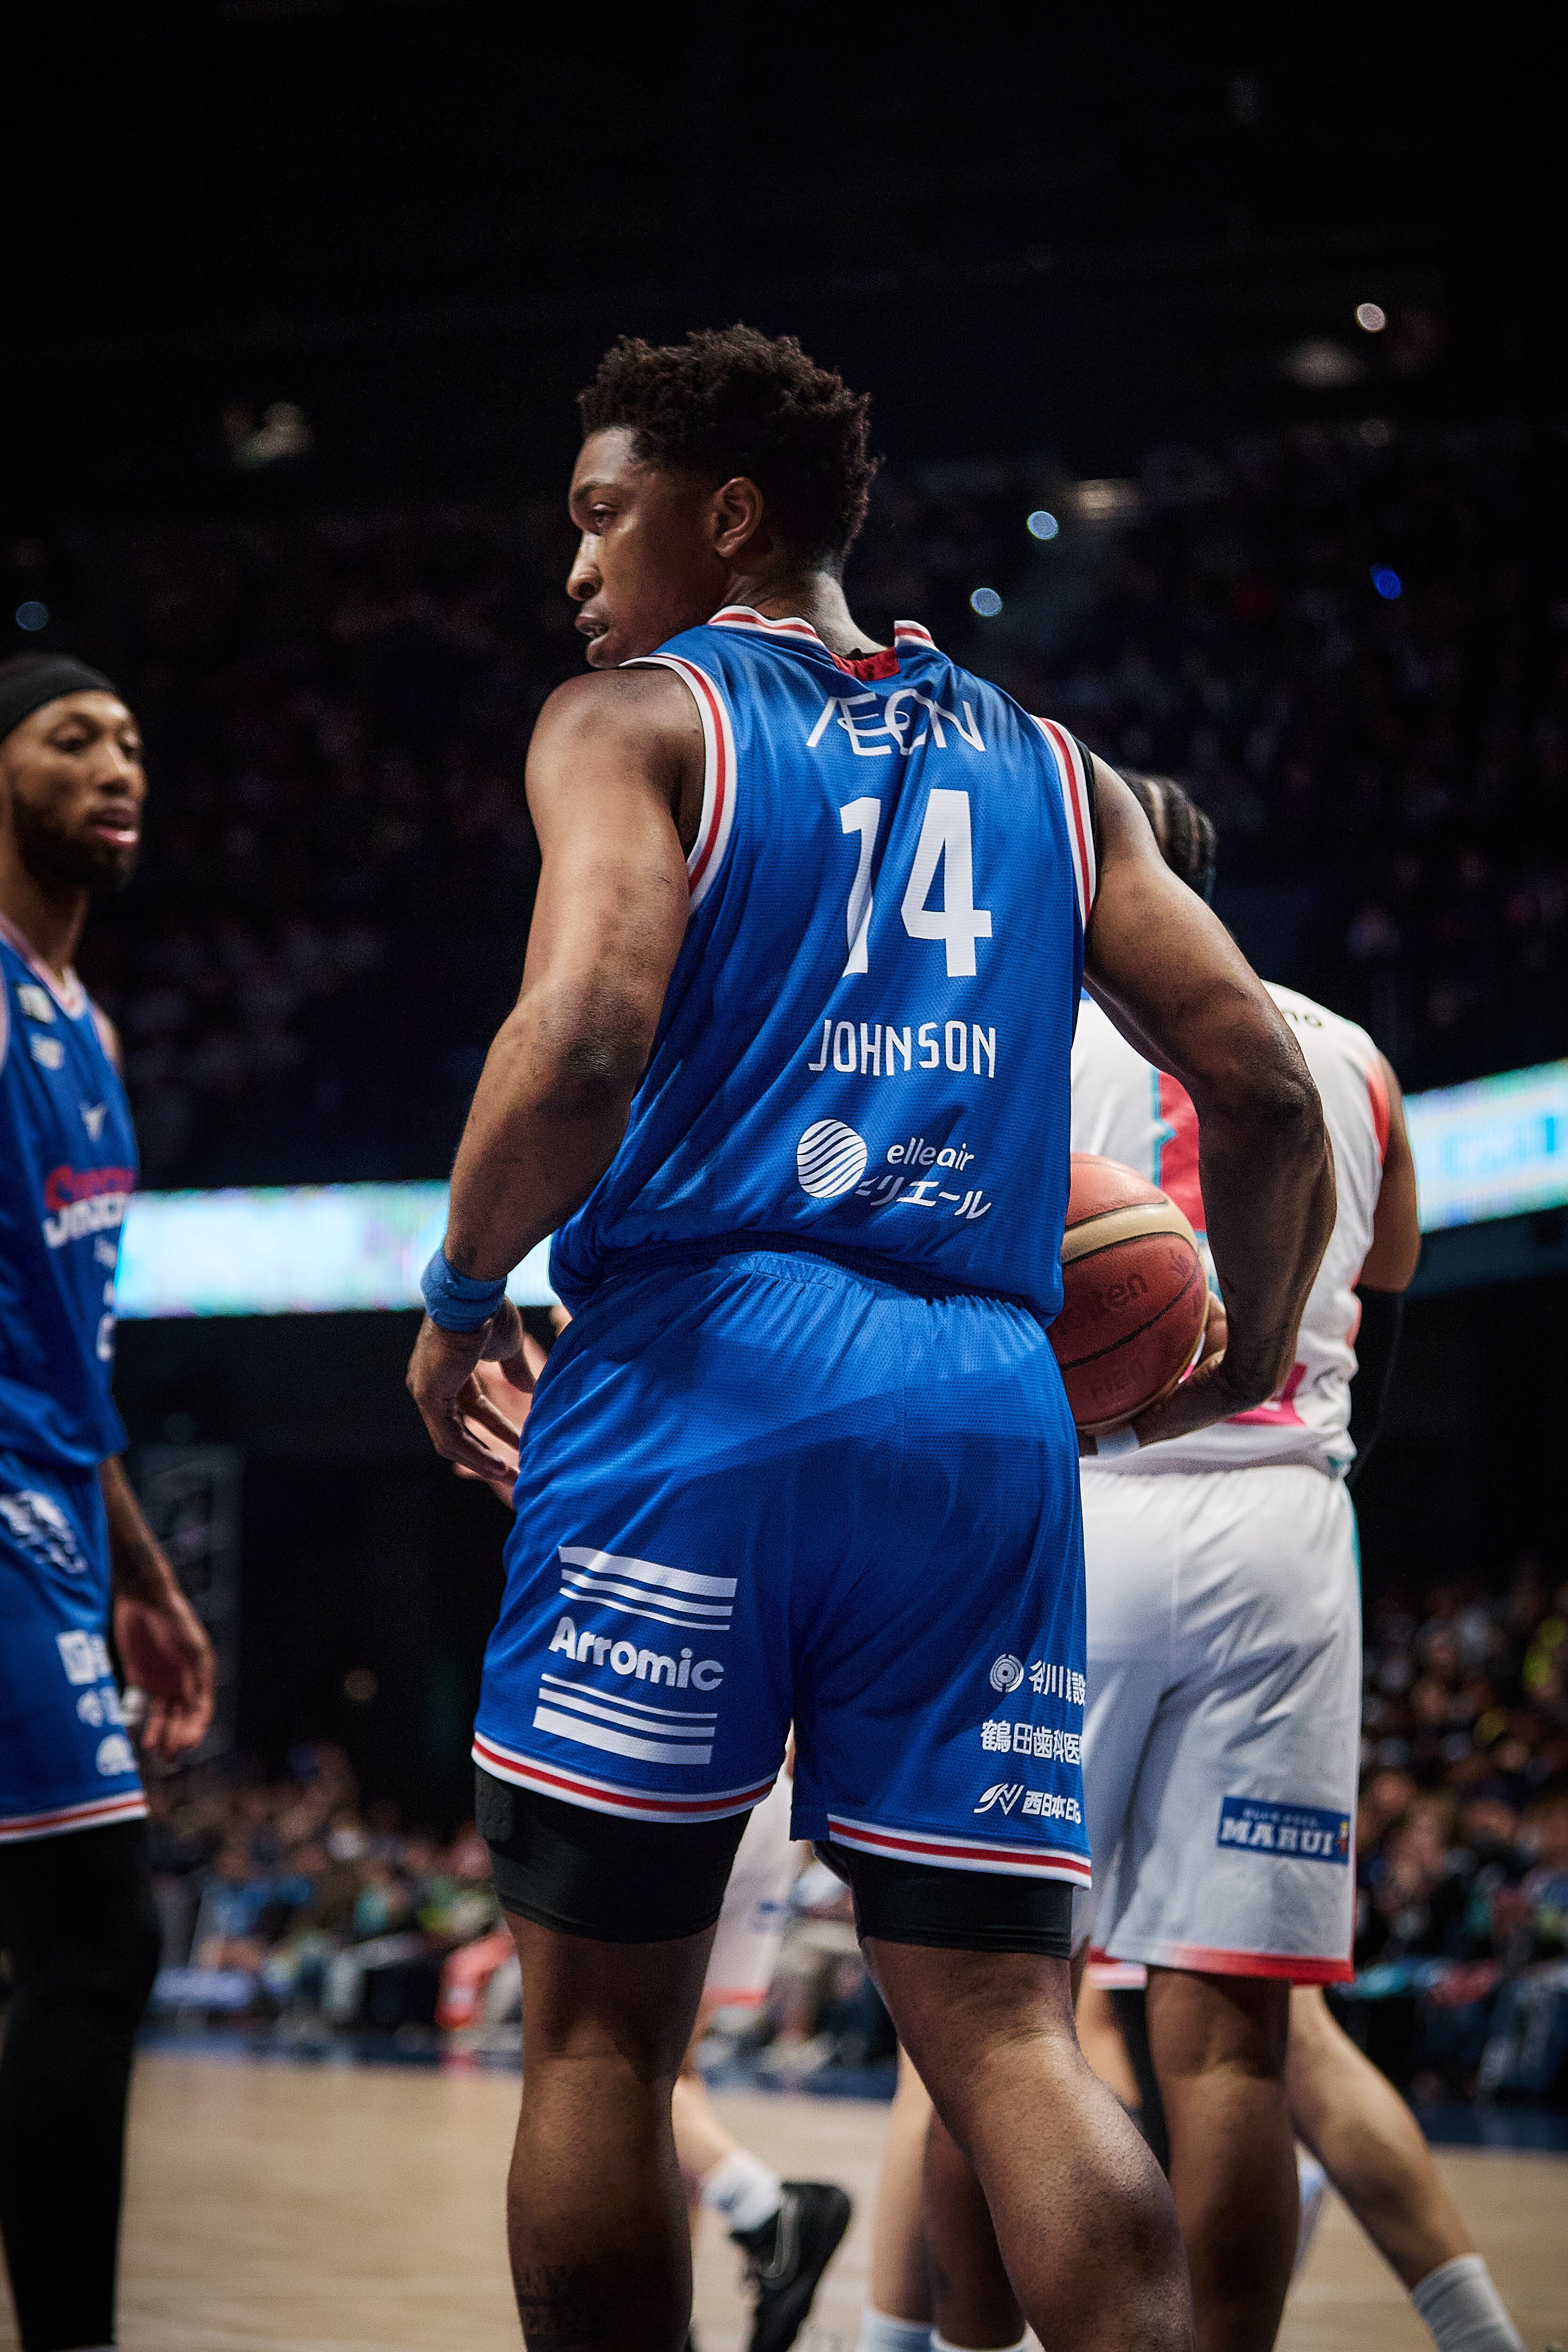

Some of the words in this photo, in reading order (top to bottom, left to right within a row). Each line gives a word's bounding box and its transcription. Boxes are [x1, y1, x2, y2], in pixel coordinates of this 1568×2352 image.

[840, 788, 992, 977] 14
[808, 1019, 996, 1078] JOHNSON
[887, 1137, 974, 1171] elleair
[548, 1616, 724, 1691] Arromic
[980, 1719, 1082, 1765] 鶴田歯科医
[1221, 1817, 1333, 1856] MARUI
